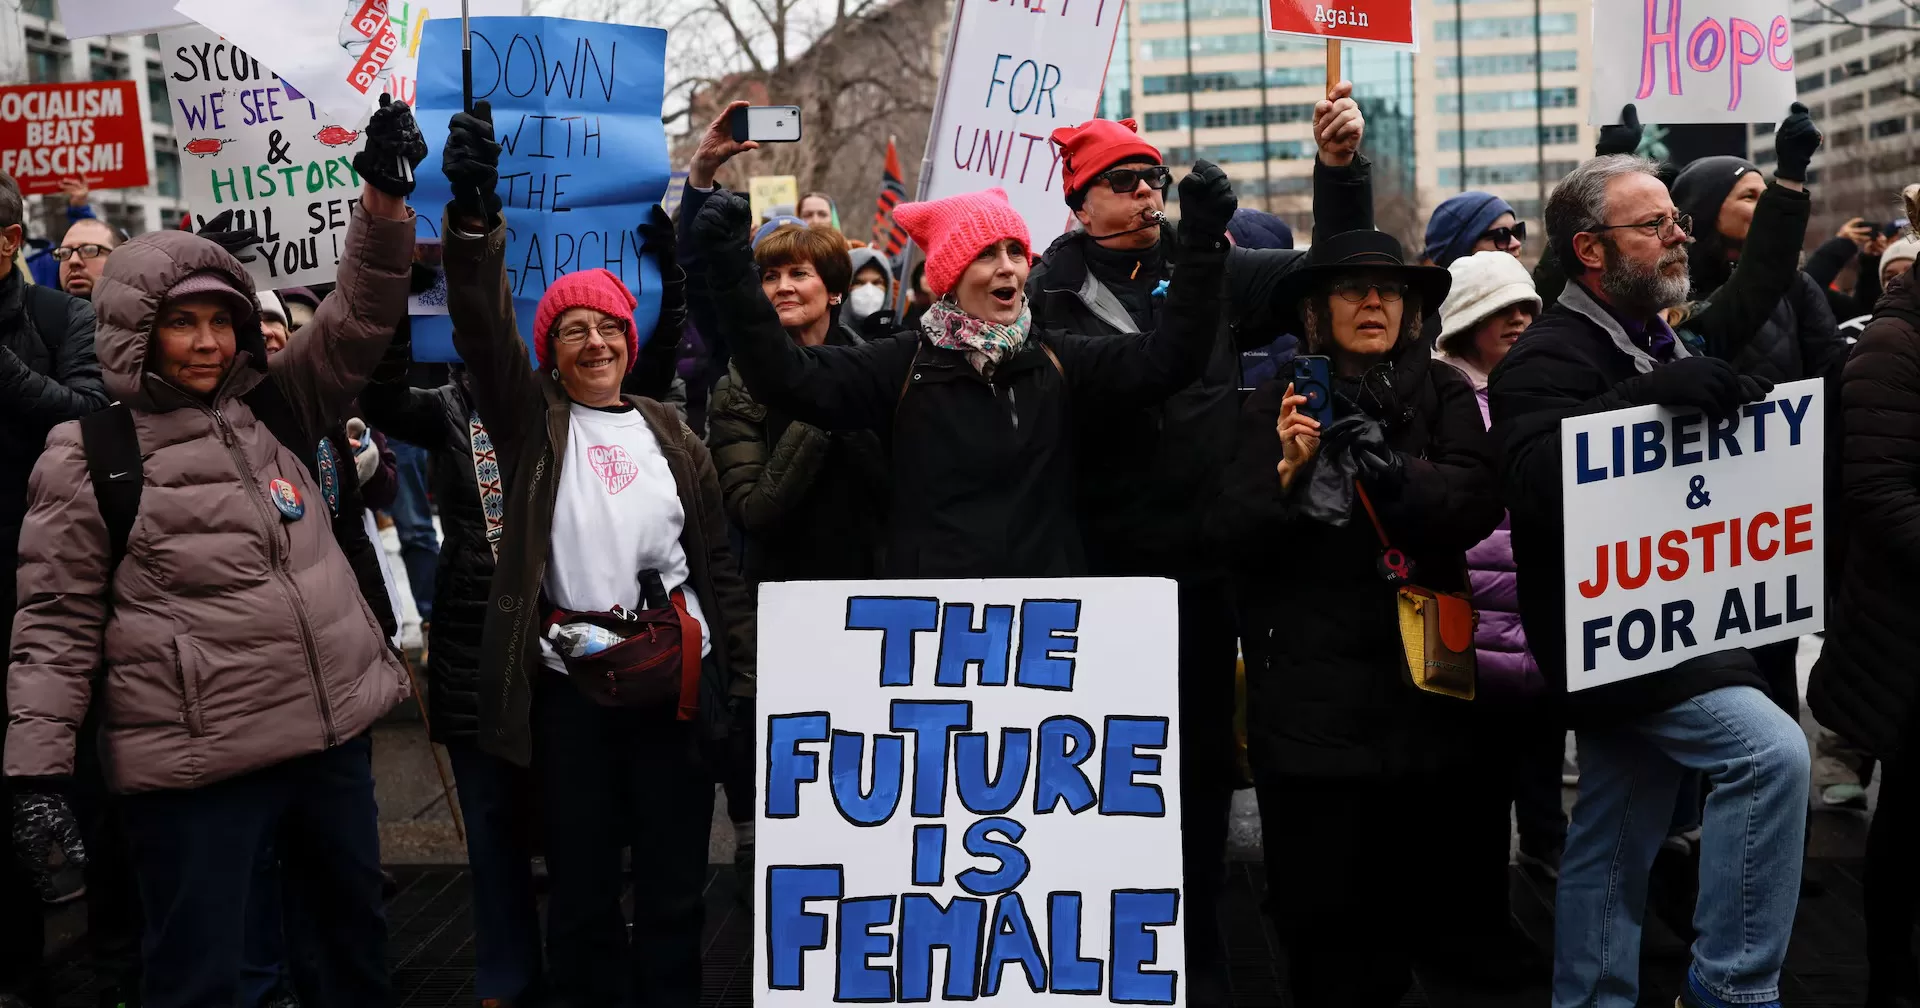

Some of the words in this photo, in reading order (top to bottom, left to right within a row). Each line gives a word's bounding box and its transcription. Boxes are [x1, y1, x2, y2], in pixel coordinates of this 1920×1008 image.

[1314, 4, 1369, 29] Again
[469, 30, 616, 102] DOWN
[986, 53, 1061, 119] FOR
[1635, 0, 1794, 111] Hope
[0, 87, 124, 122] OCIALISM
[26, 119, 95, 147] BEATS
[177, 92, 226, 131] WE
[240, 88, 284, 126] SEE
[2, 142, 124, 178] FASCISM!
[210, 156, 362, 204] HISTORY
[267, 130, 292, 165] &
[954, 125, 1062, 192] UNITY
[307, 199, 359, 235] SE
[499, 172, 571, 212] THE
[1576, 394, 1814, 485] LIBERTY
[1686, 475, 1712, 510] &
[1578, 503, 1814, 599] JUSTICE
[845, 596, 1081, 691] THE
[1583, 599, 1698, 672] FOR
[1714, 574, 1814, 641] ALL
[765, 699, 1169, 827] FUTURE
[912, 816, 1030, 897] IS
[765, 864, 1180, 1006] FEMALE
